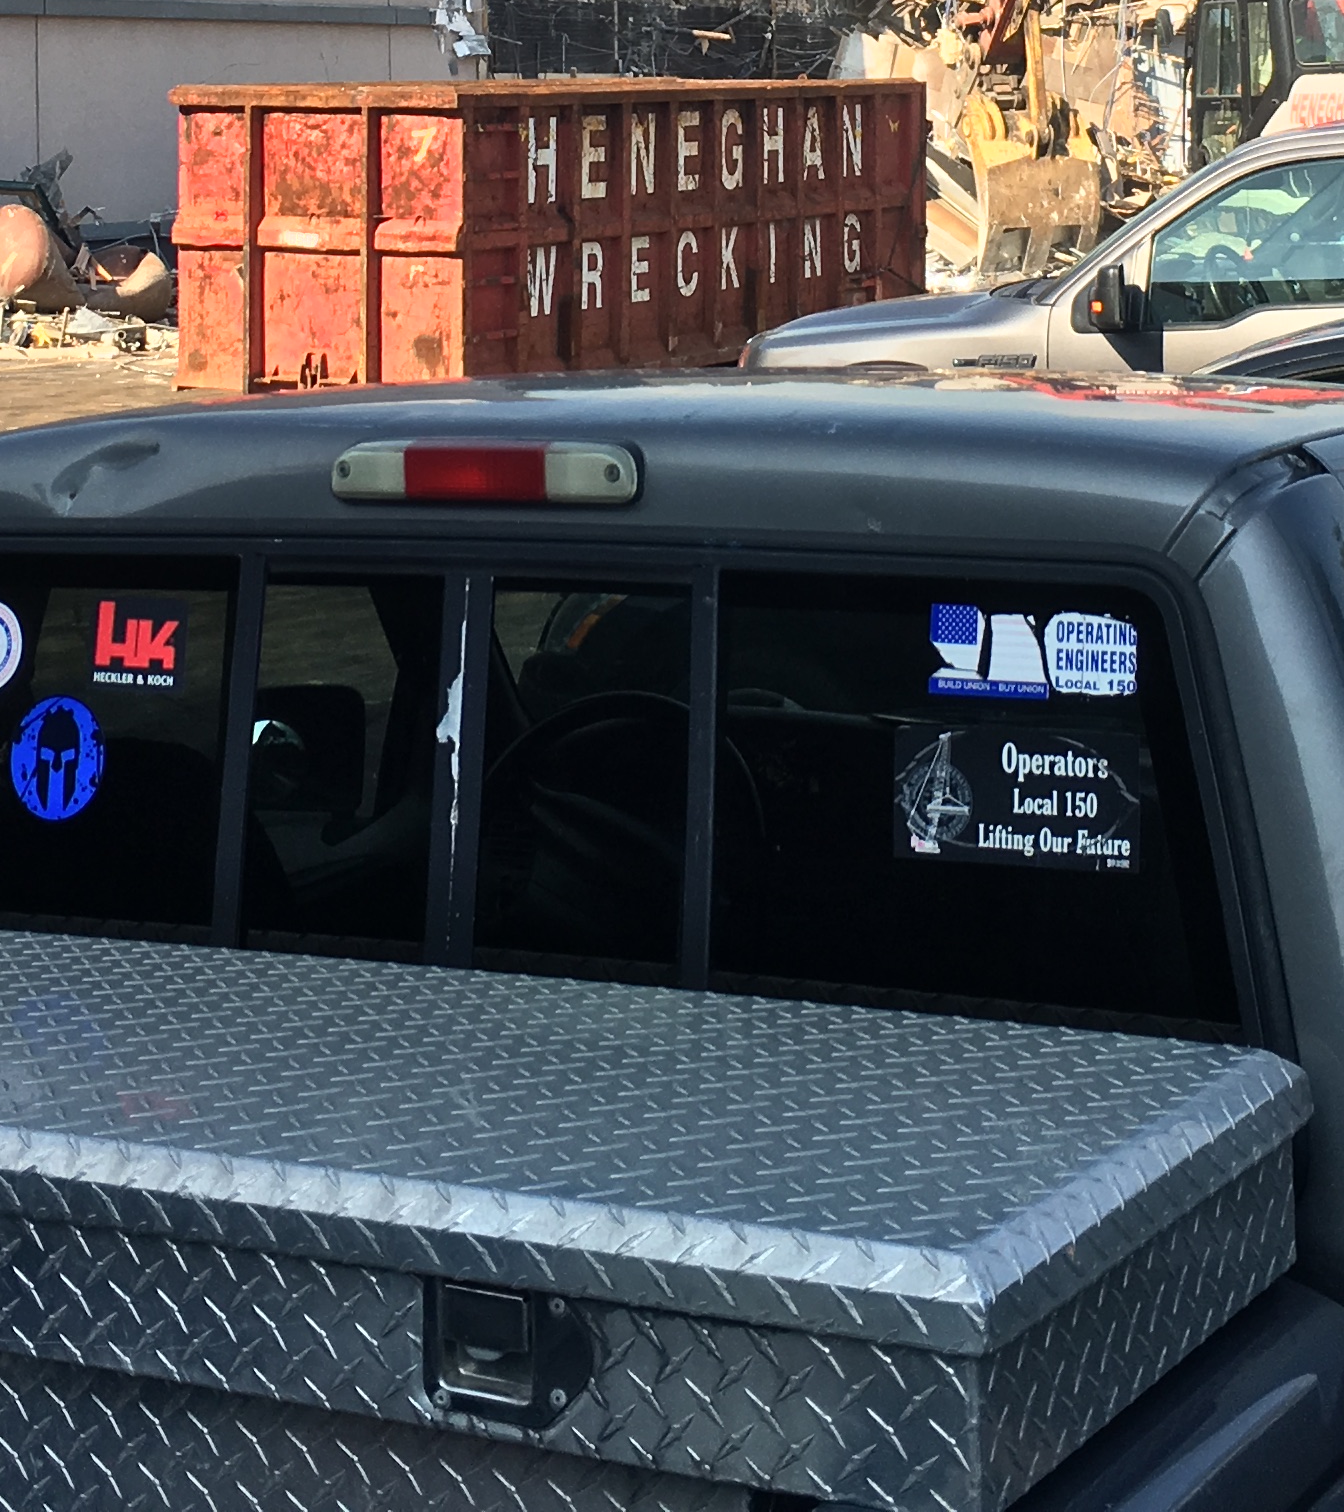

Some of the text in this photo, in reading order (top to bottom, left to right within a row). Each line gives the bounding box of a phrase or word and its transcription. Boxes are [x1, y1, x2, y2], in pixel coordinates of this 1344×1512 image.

[527, 104, 862, 205] HENEGHAN
[527, 214, 862, 317] WRECKING
[1056, 620, 1137, 646] OPERATING
[1056, 648, 1136, 675] ENGINEERS
[93, 671, 174, 686] HECKLER & KOCH
[937, 678, 963, 689] BUILD
[963, 680, 991, 691] UNION
[998, 682, 1016, 693] BUY
[1017, 683, 1045, 694] UNION
[1107, 678, 1137, 692] 150
[1001, 741, 1109, 783] Operators
[1012, 788, 1098, 817] Local 150
[978, 823, 1131, 857] Lifting Our Future
